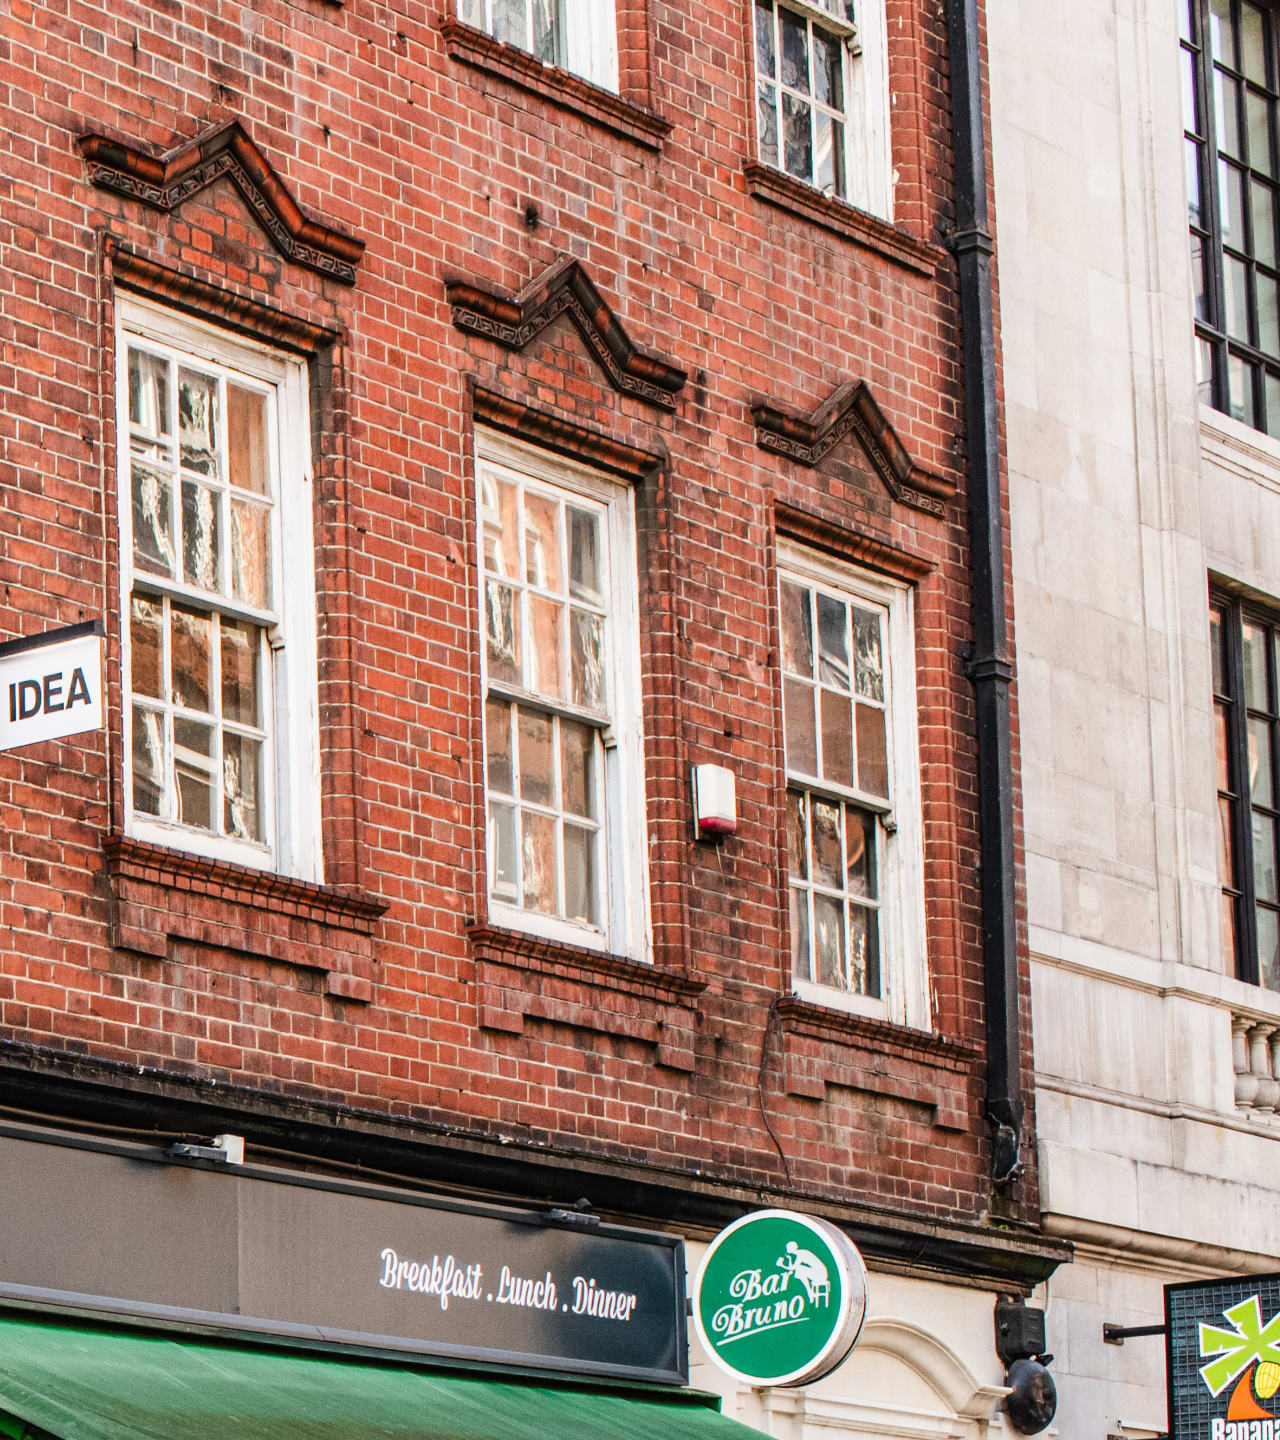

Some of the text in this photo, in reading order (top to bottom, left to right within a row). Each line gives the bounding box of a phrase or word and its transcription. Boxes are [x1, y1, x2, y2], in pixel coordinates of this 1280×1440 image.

[9, 666, 92, 723] IDEA
[379, 1248, 637, 1321] Breakfast Lunch Dinner
[729, 1268, 793, 1303] Bar
[711, 1295, 805, 1337] Bruno
